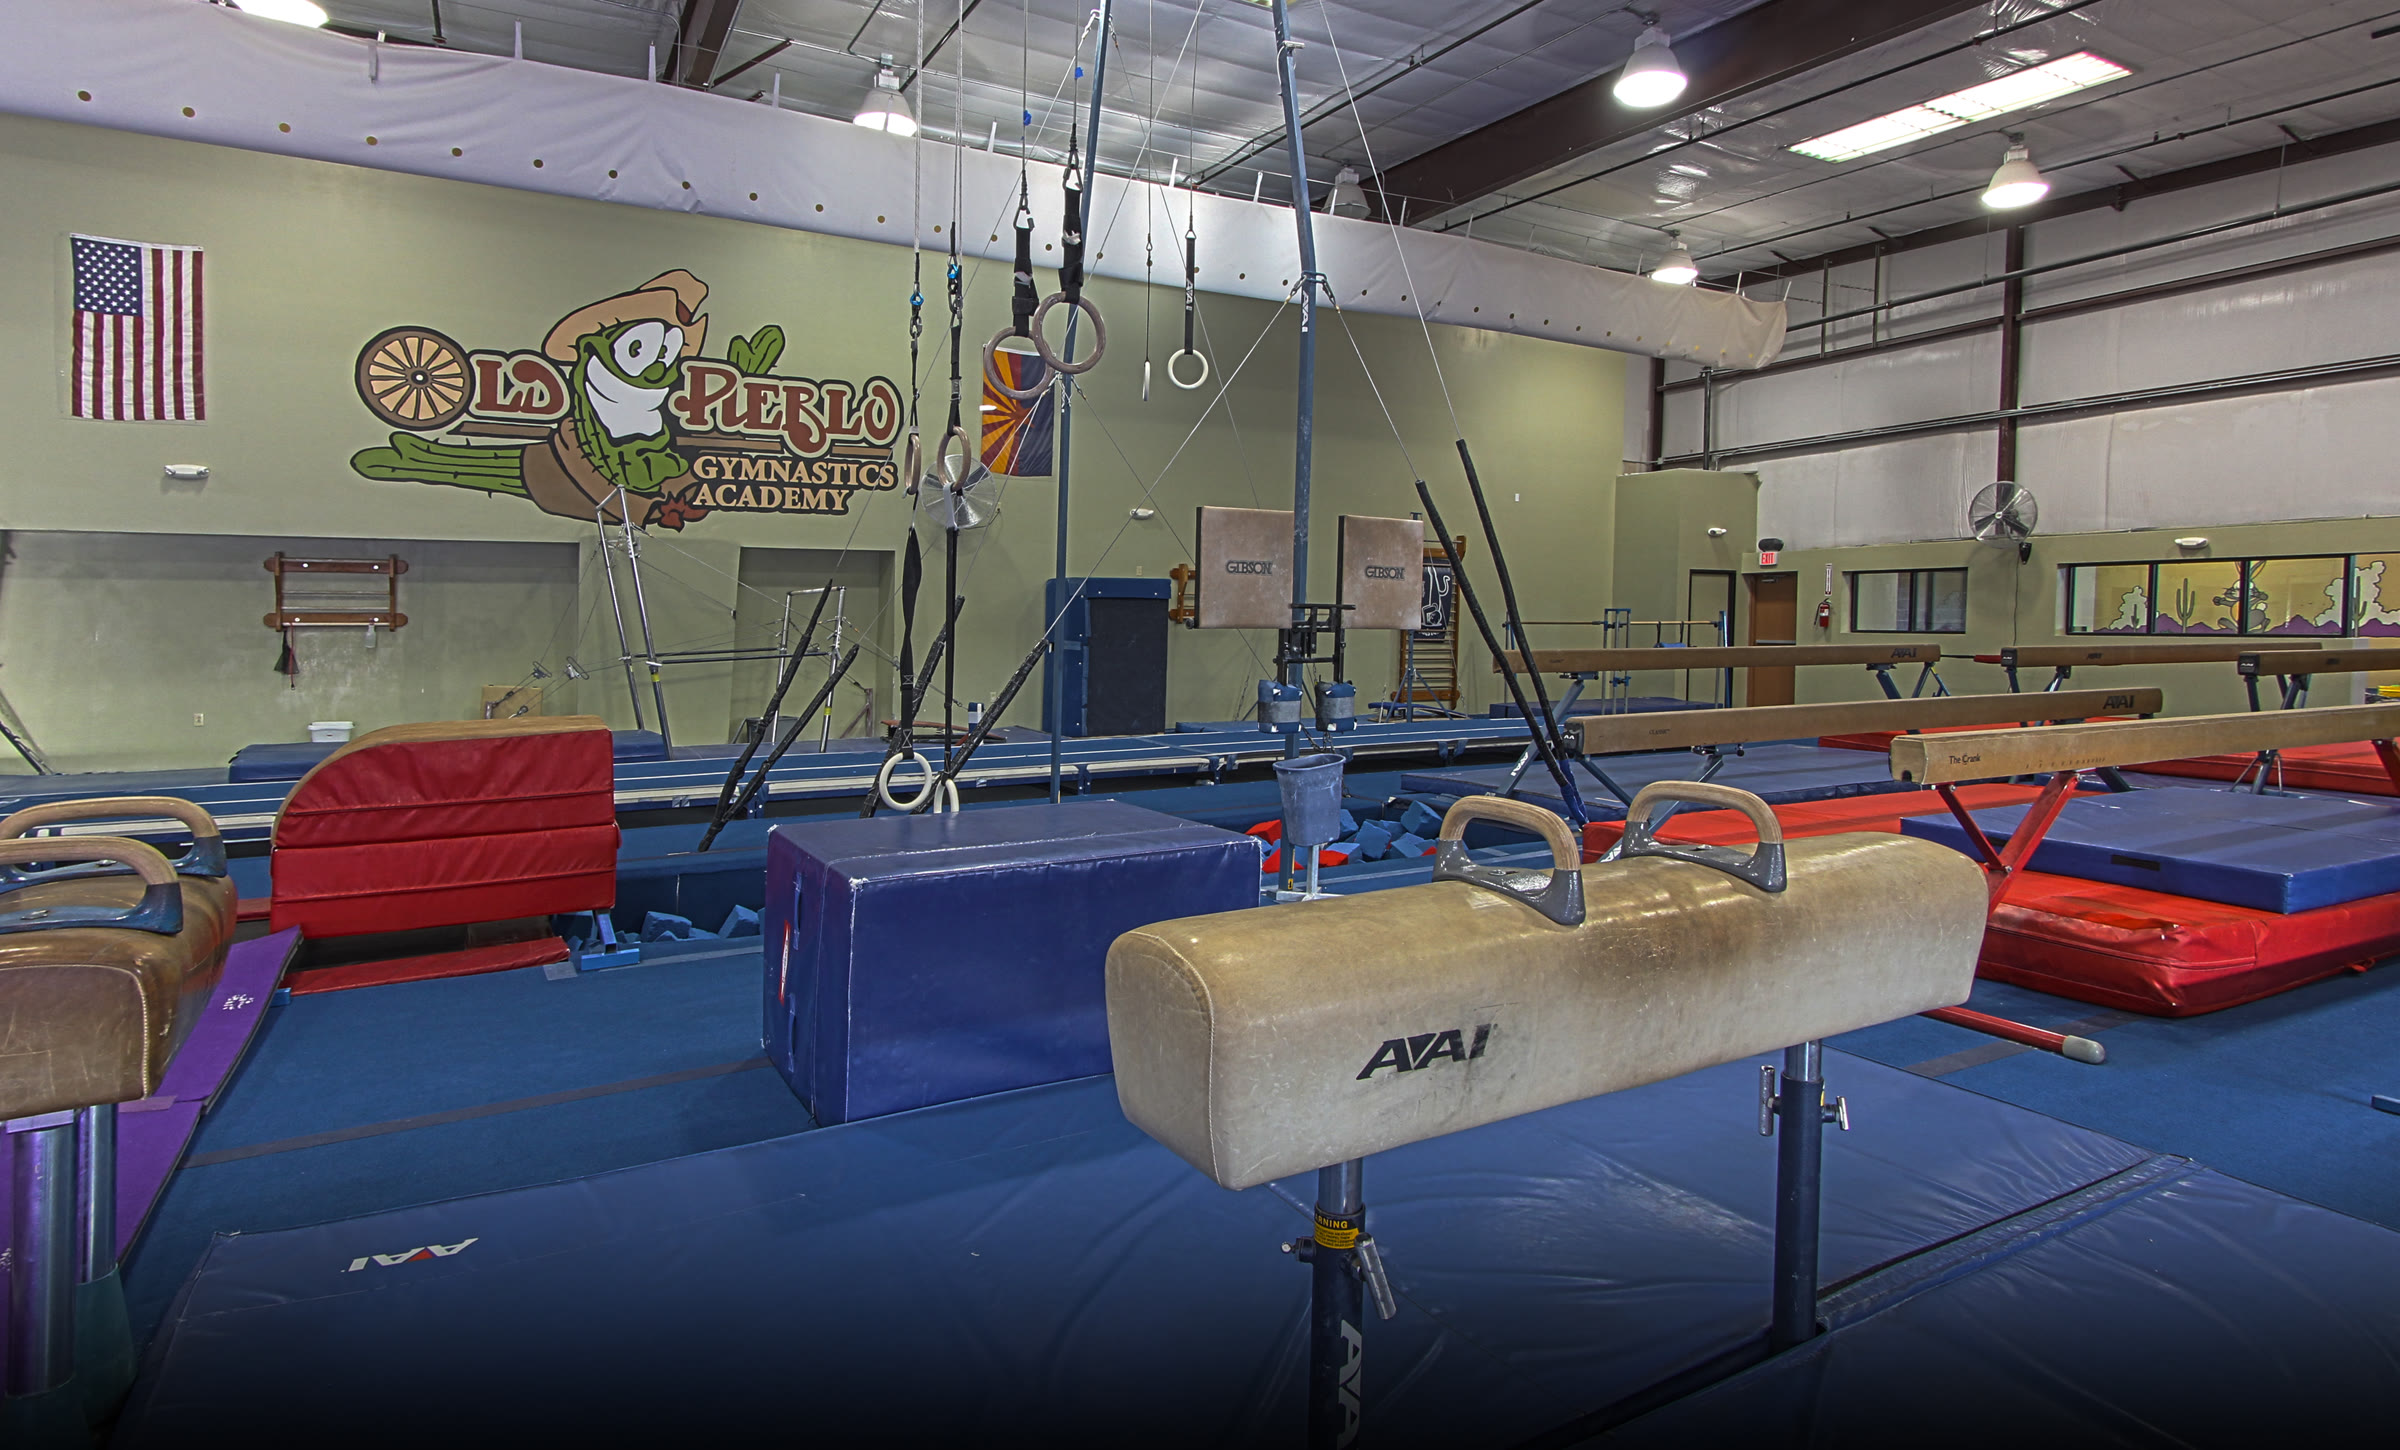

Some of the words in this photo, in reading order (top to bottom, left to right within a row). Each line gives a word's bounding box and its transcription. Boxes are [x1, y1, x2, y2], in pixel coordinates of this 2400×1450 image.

[674, 366, 896, 453] PUEBLO
[693, 456, 895, 487] GYMNASTICS
[693, 483, 850, 511] ACADEMY
[1761, 552, 1775, 564] EXIT
[1226, 561, 1273, 574] GIBSON
[1365, 566, 1406, 580] GIBSON
[1948, 755, 1961, 764] The
